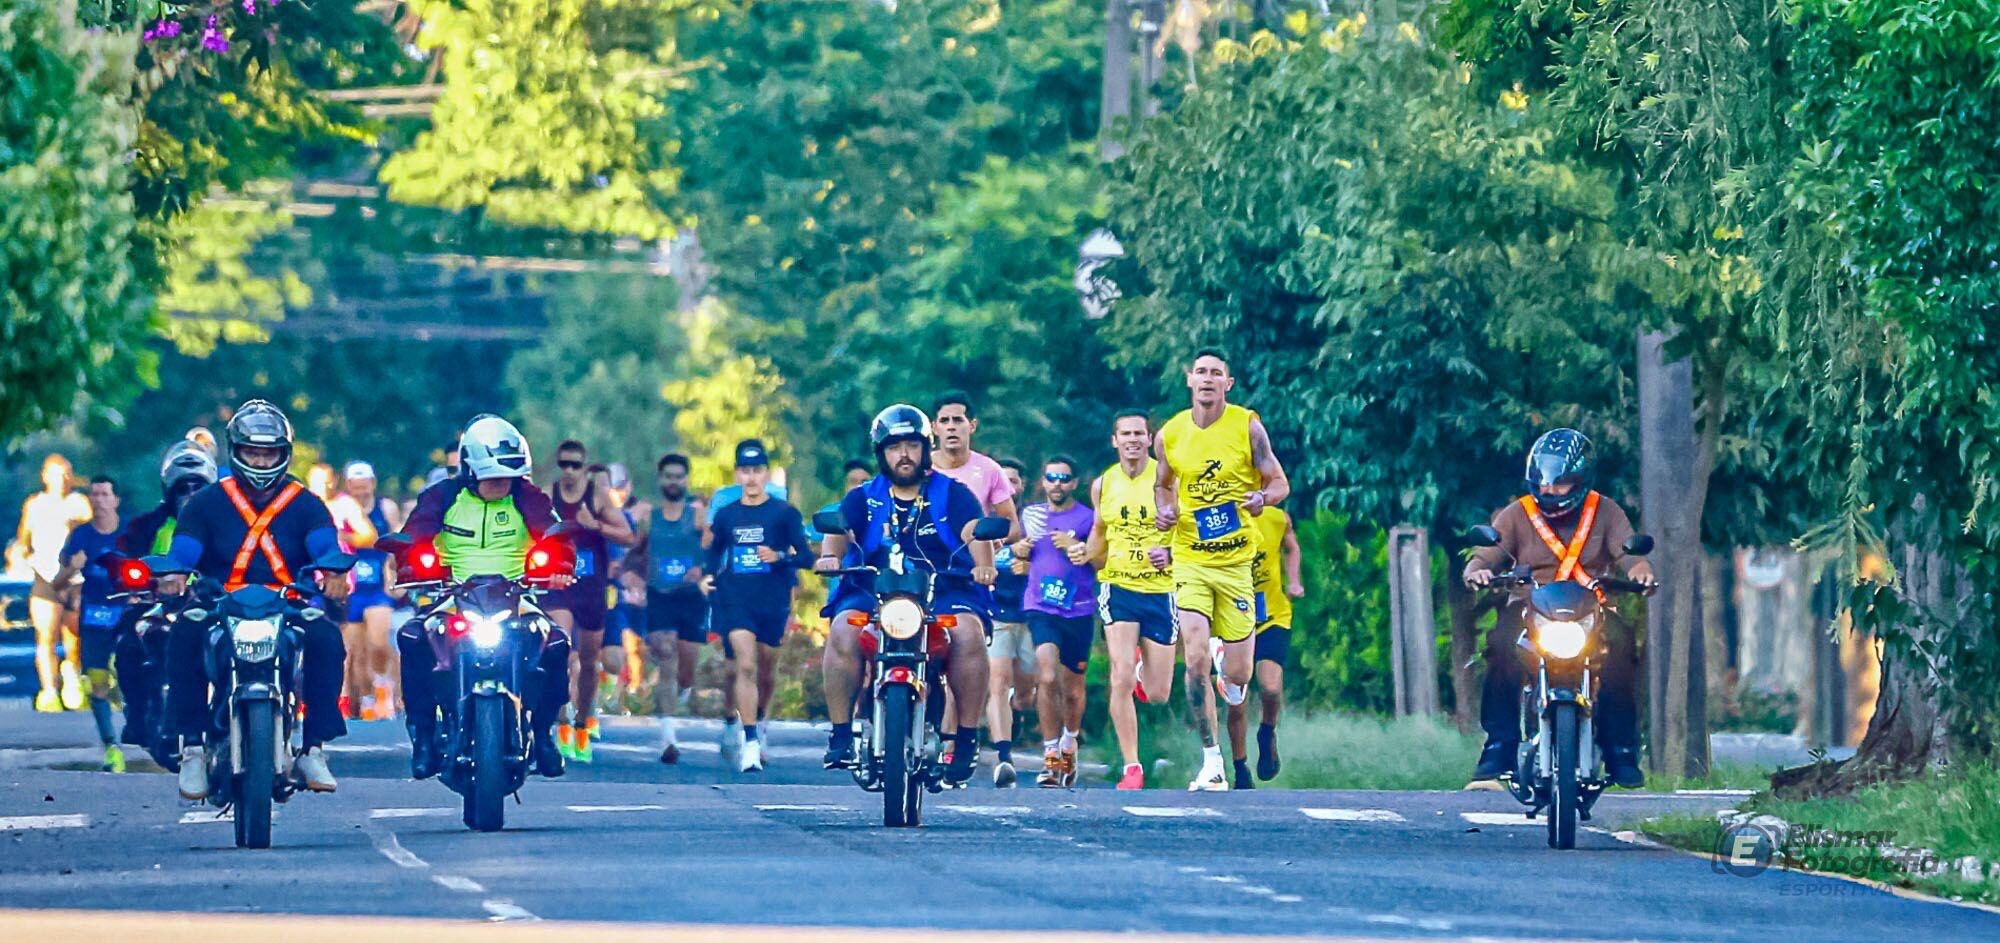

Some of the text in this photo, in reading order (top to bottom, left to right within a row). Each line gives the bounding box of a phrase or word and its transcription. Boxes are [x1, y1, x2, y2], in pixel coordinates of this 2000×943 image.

[1205, 513, 1229, 528] 385
[1128, 550, 1144, 561] 76
[1046, 583, 1068, 601] 382
